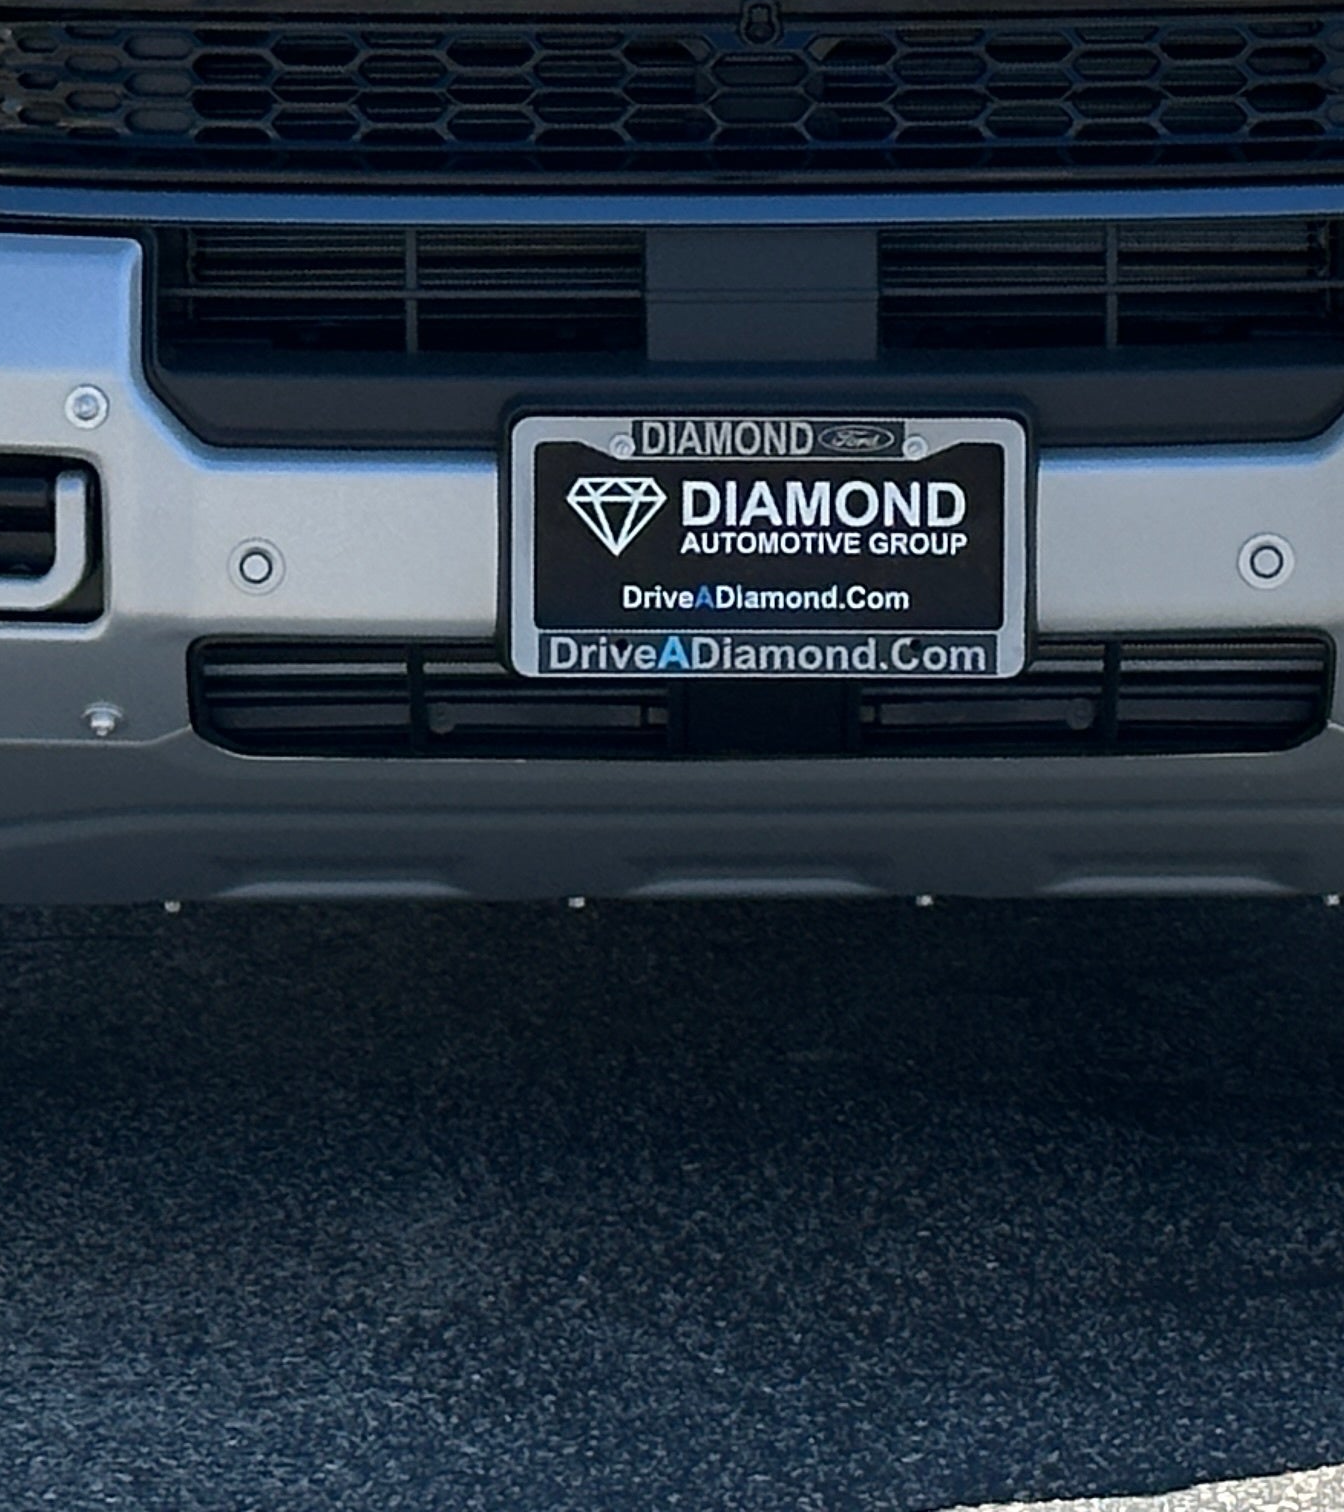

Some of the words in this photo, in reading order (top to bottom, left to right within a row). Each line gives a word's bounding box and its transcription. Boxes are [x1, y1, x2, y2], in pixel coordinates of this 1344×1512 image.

[642, 421, 814, 455] DIAMOND
[831, 429, 881, 448] Ford
[682, 481, 966, 528] DIAMOND
[680, 532, 862, 555] AUTOMOTIVE
[868, 532, 968, 556] GROUP
[622, 585, 910, 610] DriveADiamond.Com
[549, 635, 986, 672] DriveADiamond.Com
